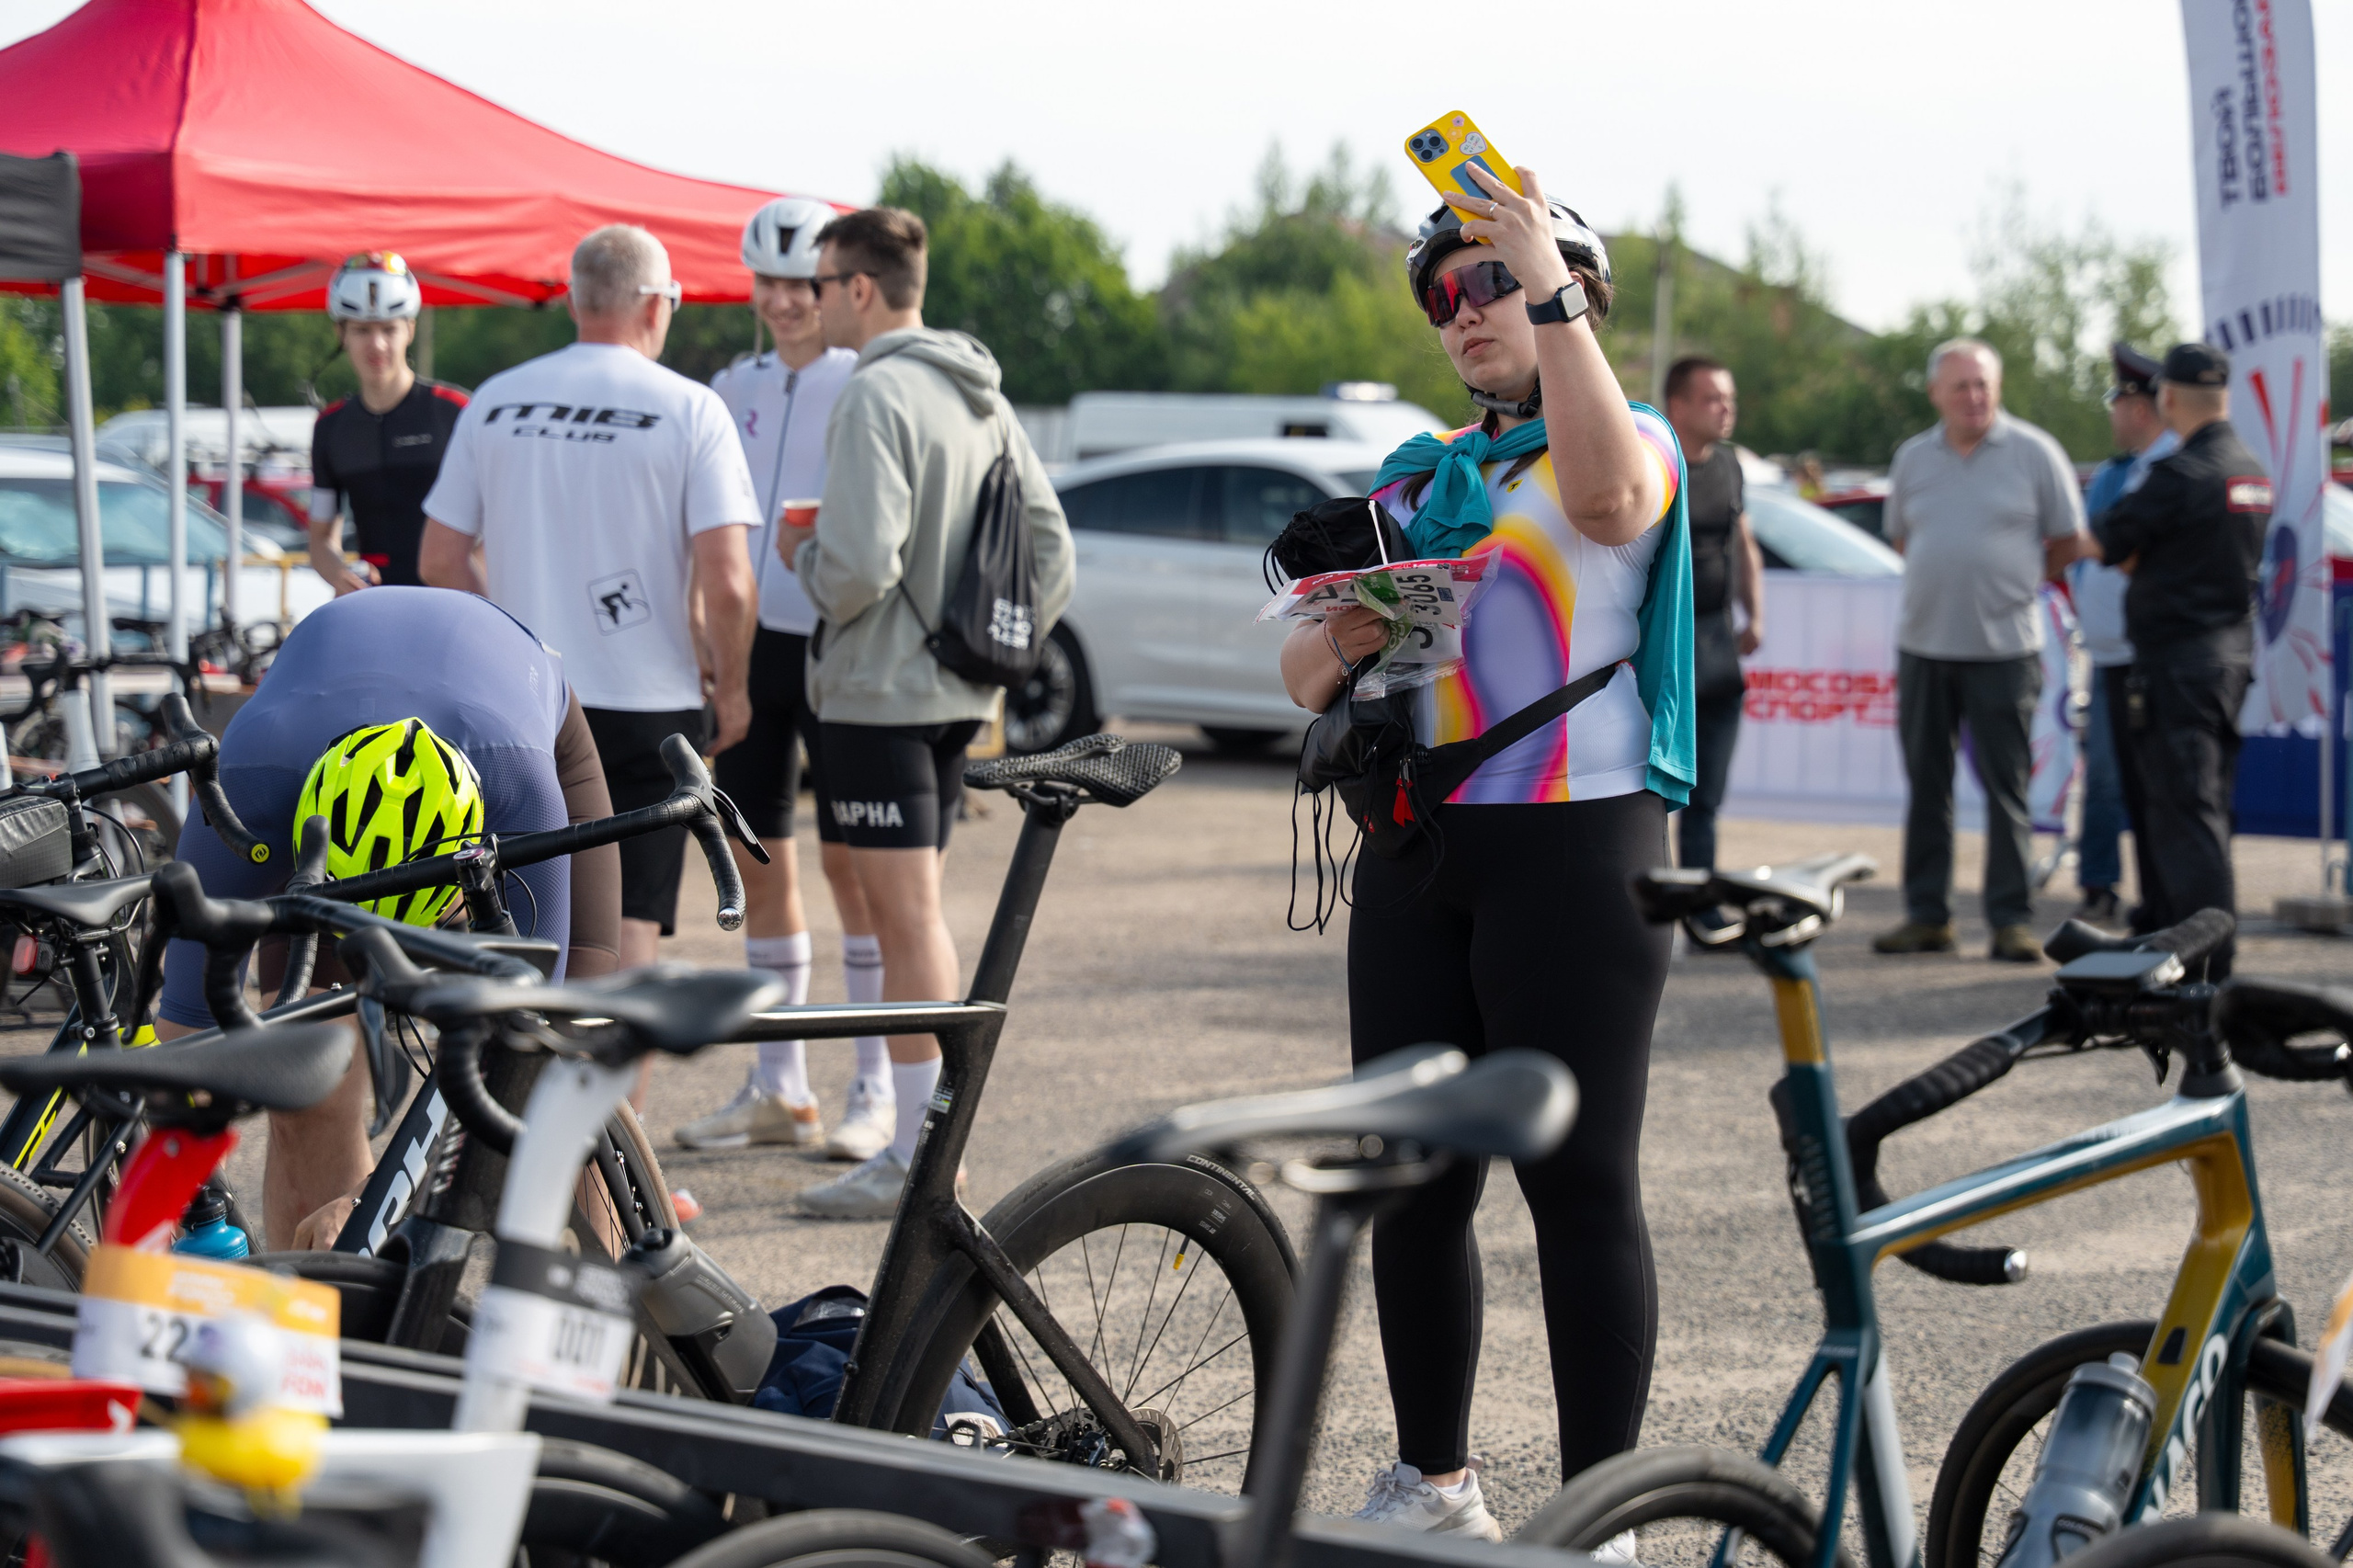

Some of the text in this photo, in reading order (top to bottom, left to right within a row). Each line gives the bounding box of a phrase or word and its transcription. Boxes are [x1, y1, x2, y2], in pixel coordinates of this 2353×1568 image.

[2232, 0, 2270, 204] БОЛЬШО
[512, 424, 617, 444] CLUB
[1186, 1154, 1256, 1200] CONTINENTAL
